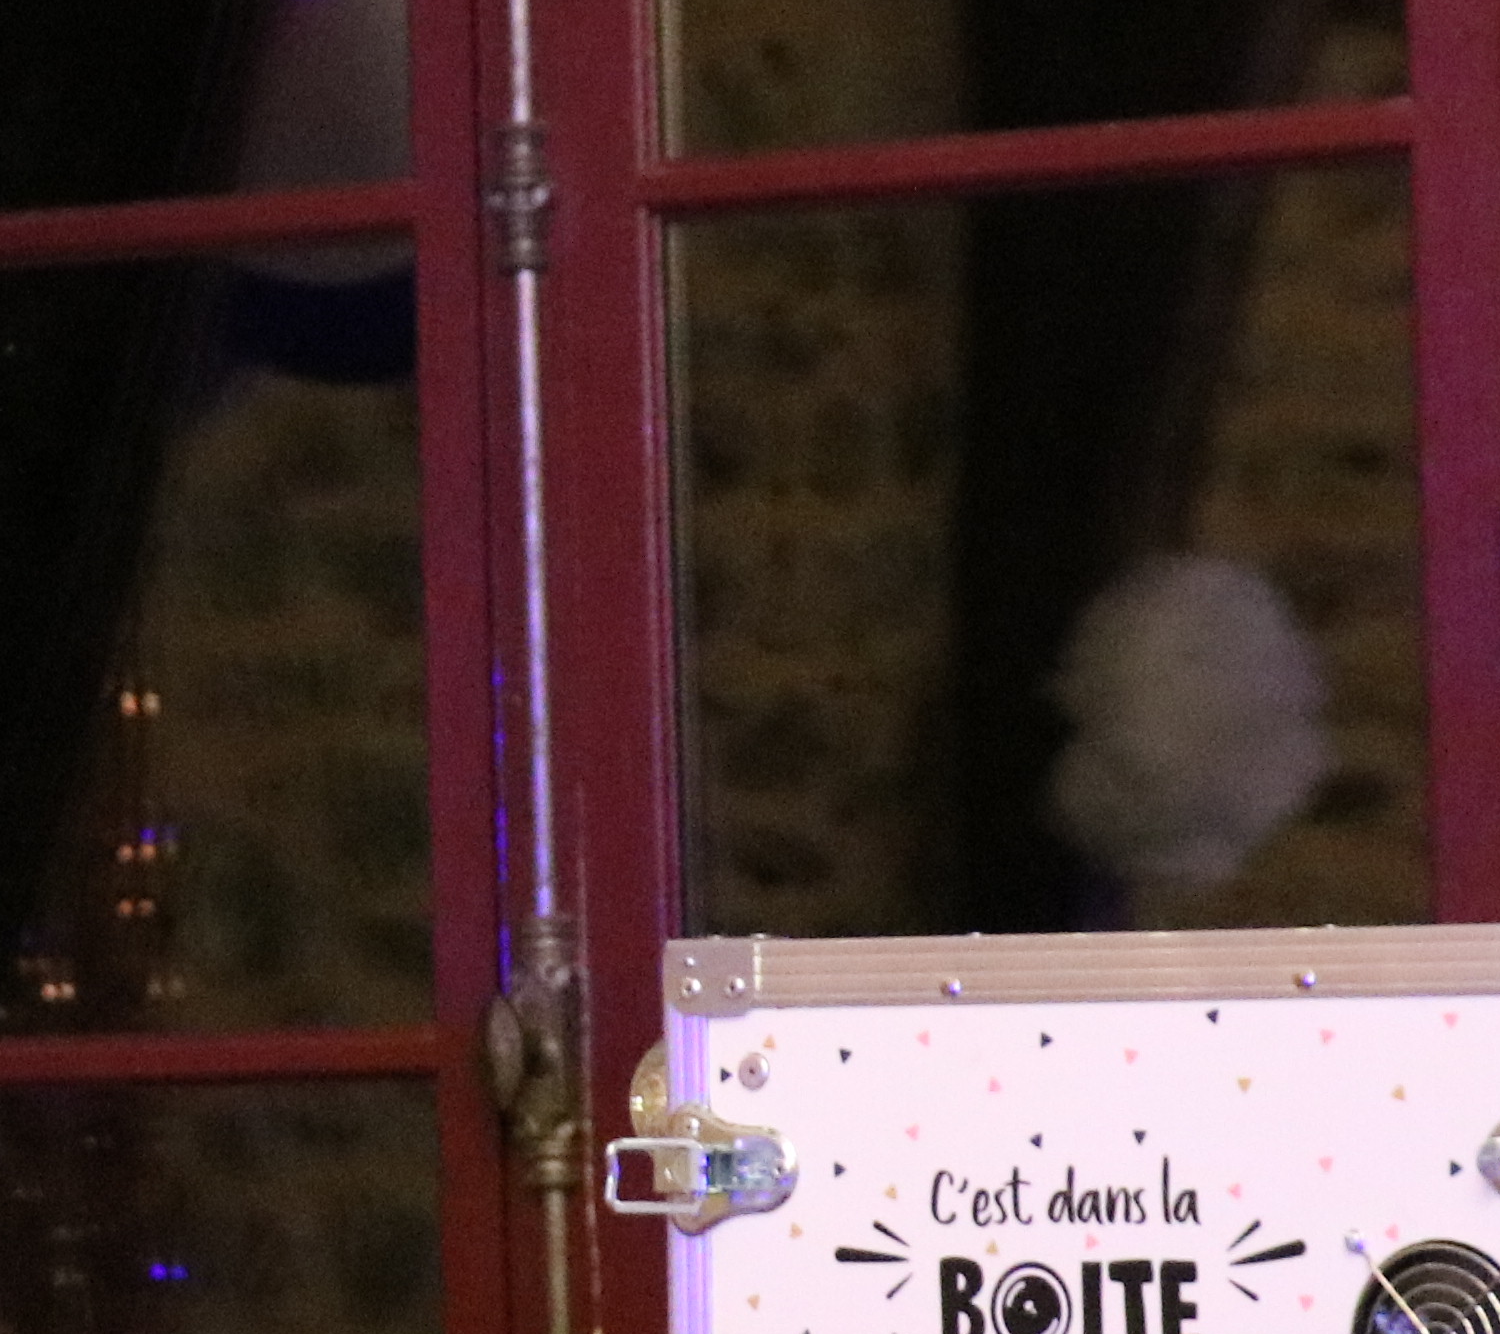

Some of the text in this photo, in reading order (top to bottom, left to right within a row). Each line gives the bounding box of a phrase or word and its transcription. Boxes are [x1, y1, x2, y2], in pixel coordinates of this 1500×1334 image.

[931, 1153, 1202, 1227] C'est dans la
